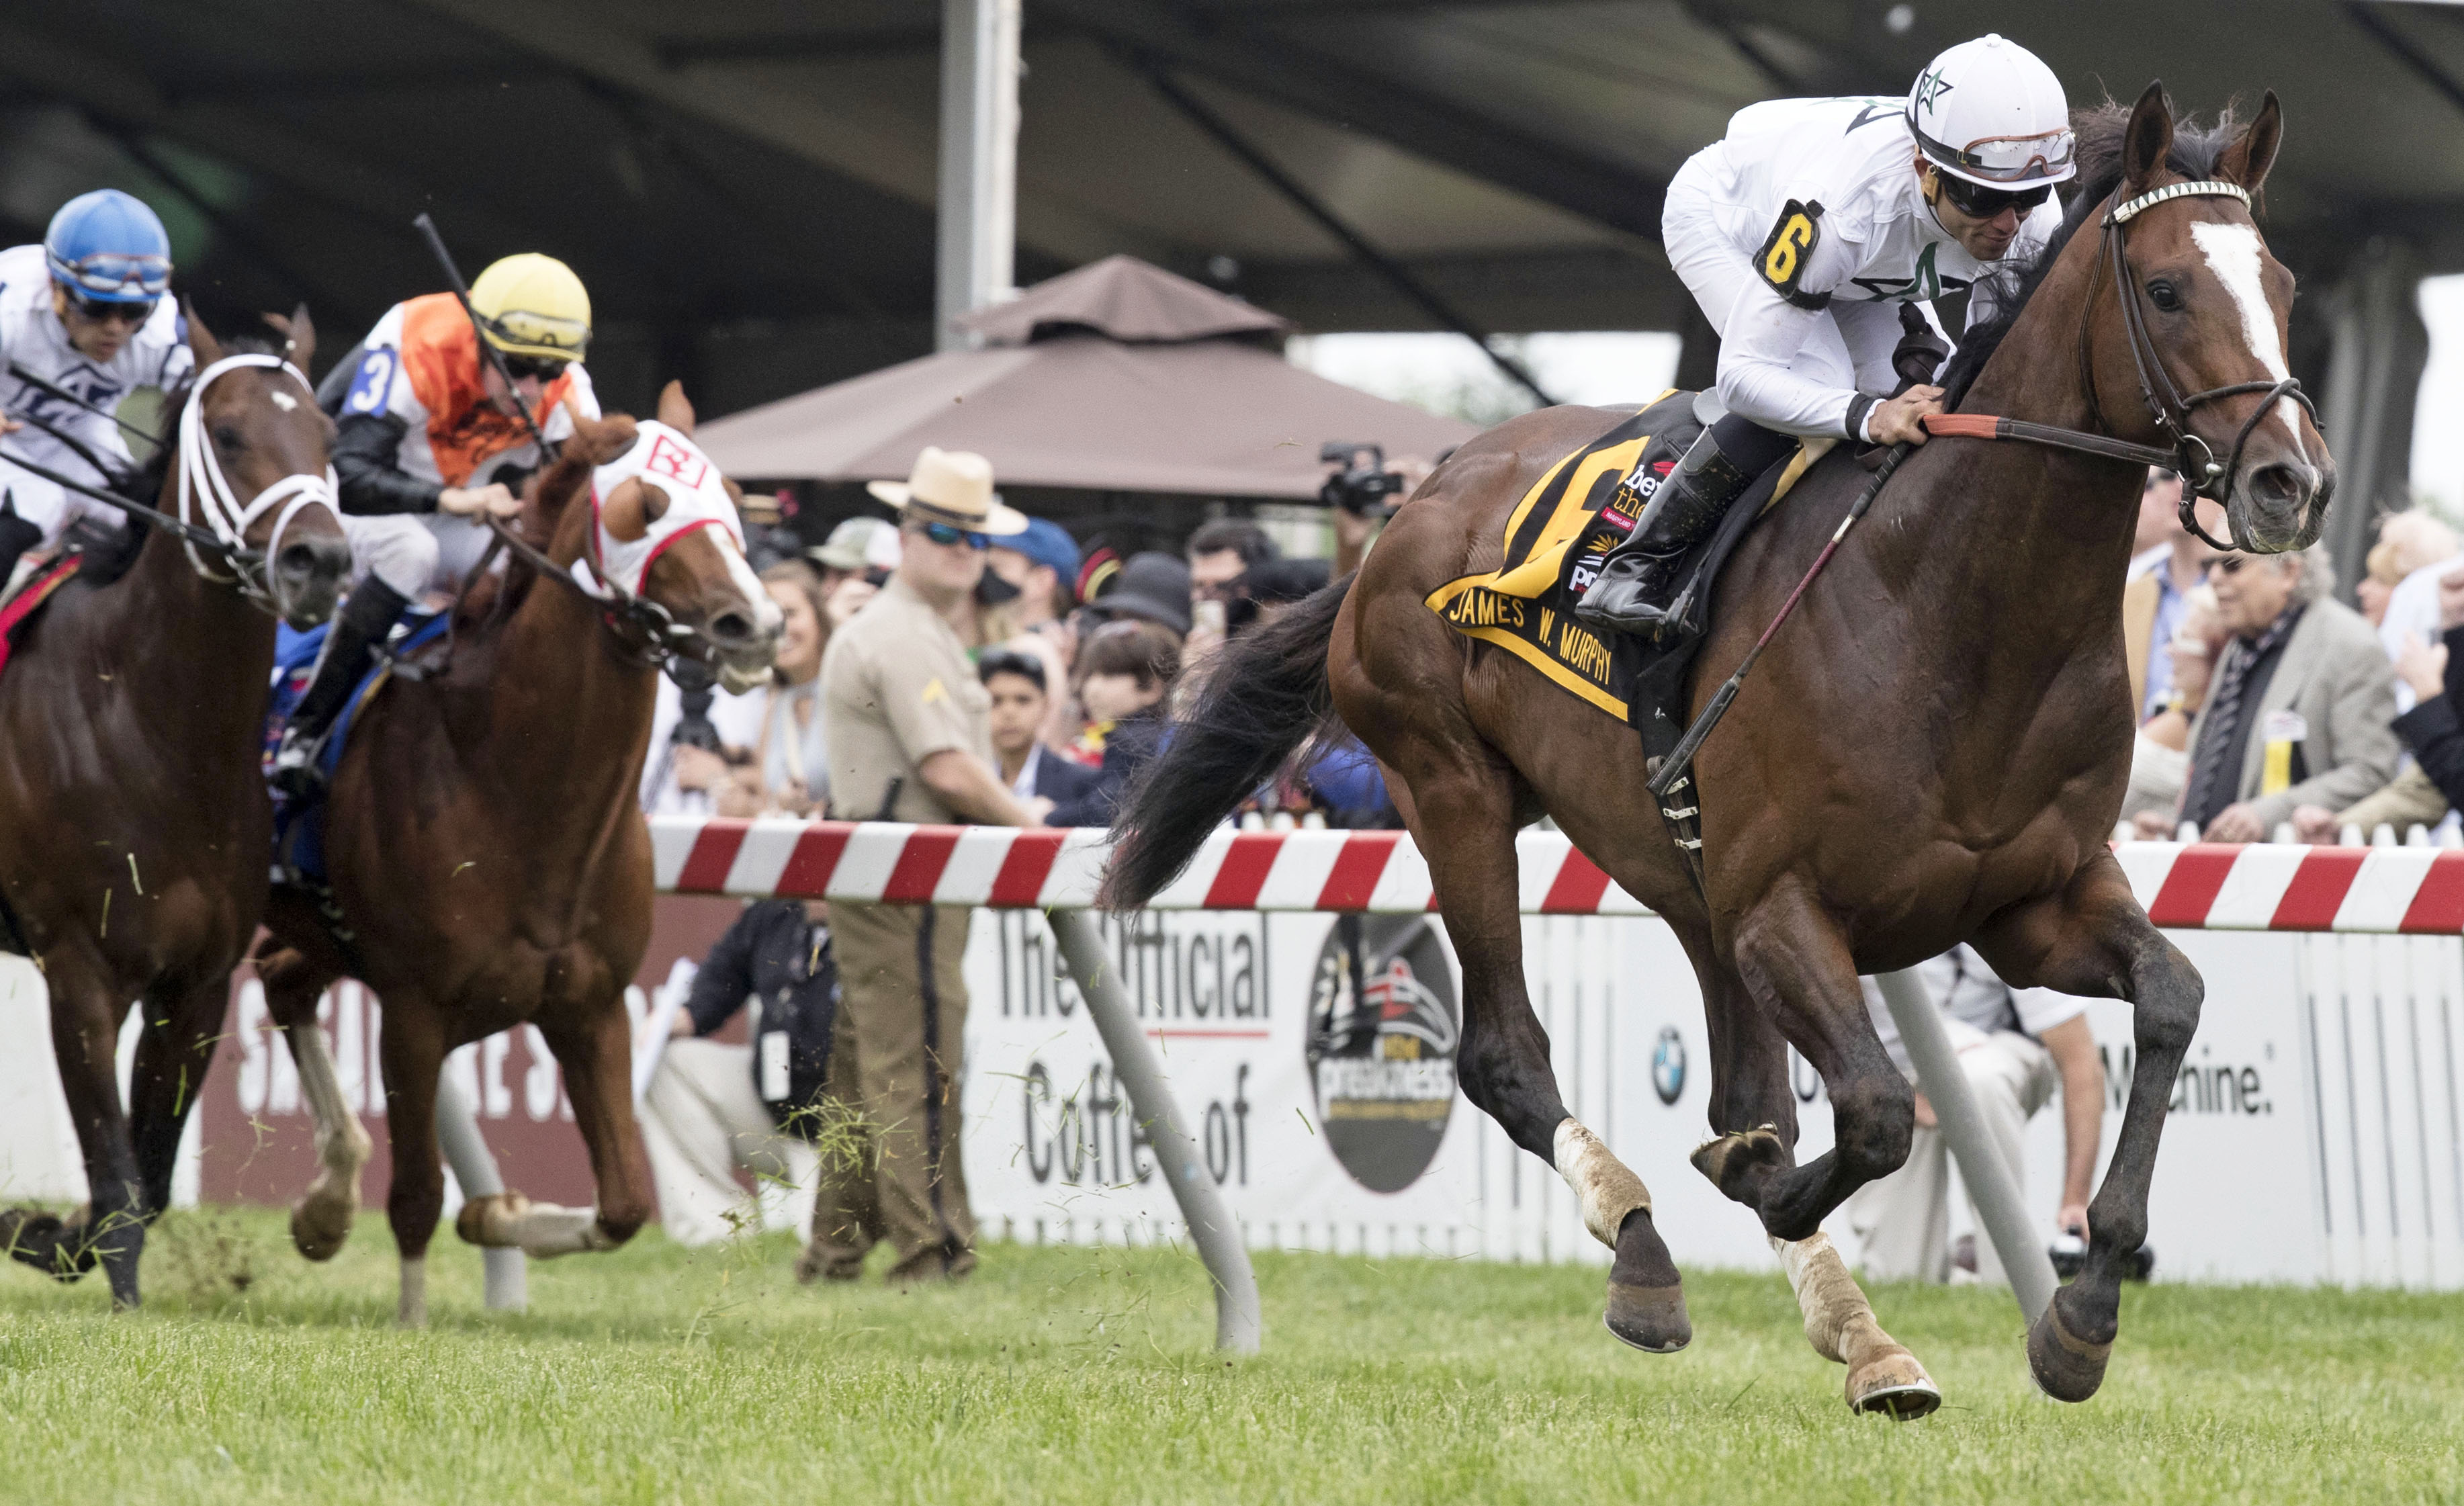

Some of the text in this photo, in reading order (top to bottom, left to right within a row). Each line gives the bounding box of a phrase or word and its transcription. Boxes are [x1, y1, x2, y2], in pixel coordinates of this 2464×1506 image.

[1765, 213, 1812, 283] 6
[351, 353, 392, 412] 3
[1605, 511, 1631, 529] MARYLAND
[1449, 588, 1612, 684] JAMES W. MURPHY
[1025, 1063, 1249, 1186] Coffe of
